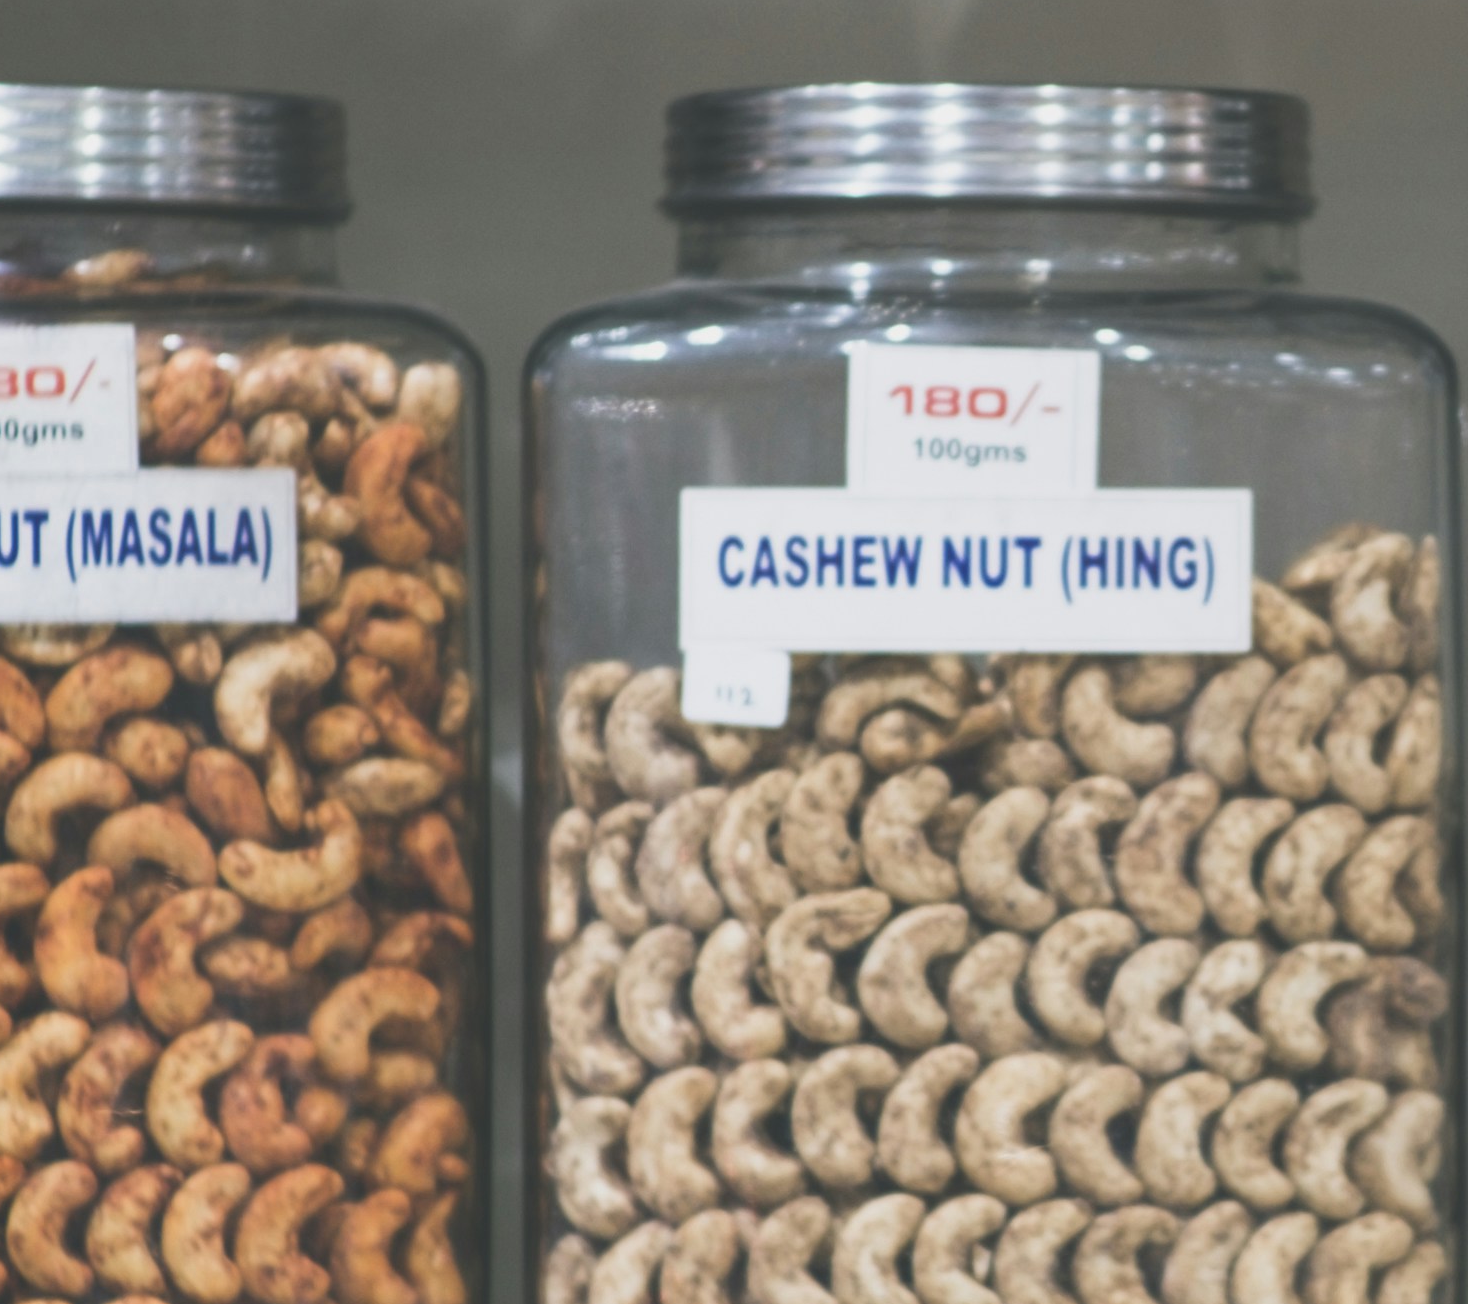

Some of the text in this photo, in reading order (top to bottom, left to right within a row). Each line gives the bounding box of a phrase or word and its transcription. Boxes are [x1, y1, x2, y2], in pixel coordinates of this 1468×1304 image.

[889, 382, 1063, 425] 180/-
[914, 437, 1028, 469] 100gms
[65, 506, 273, 583] (MASALA)
[718, 535, 1215, 602] CASHEW NUT (HING)
